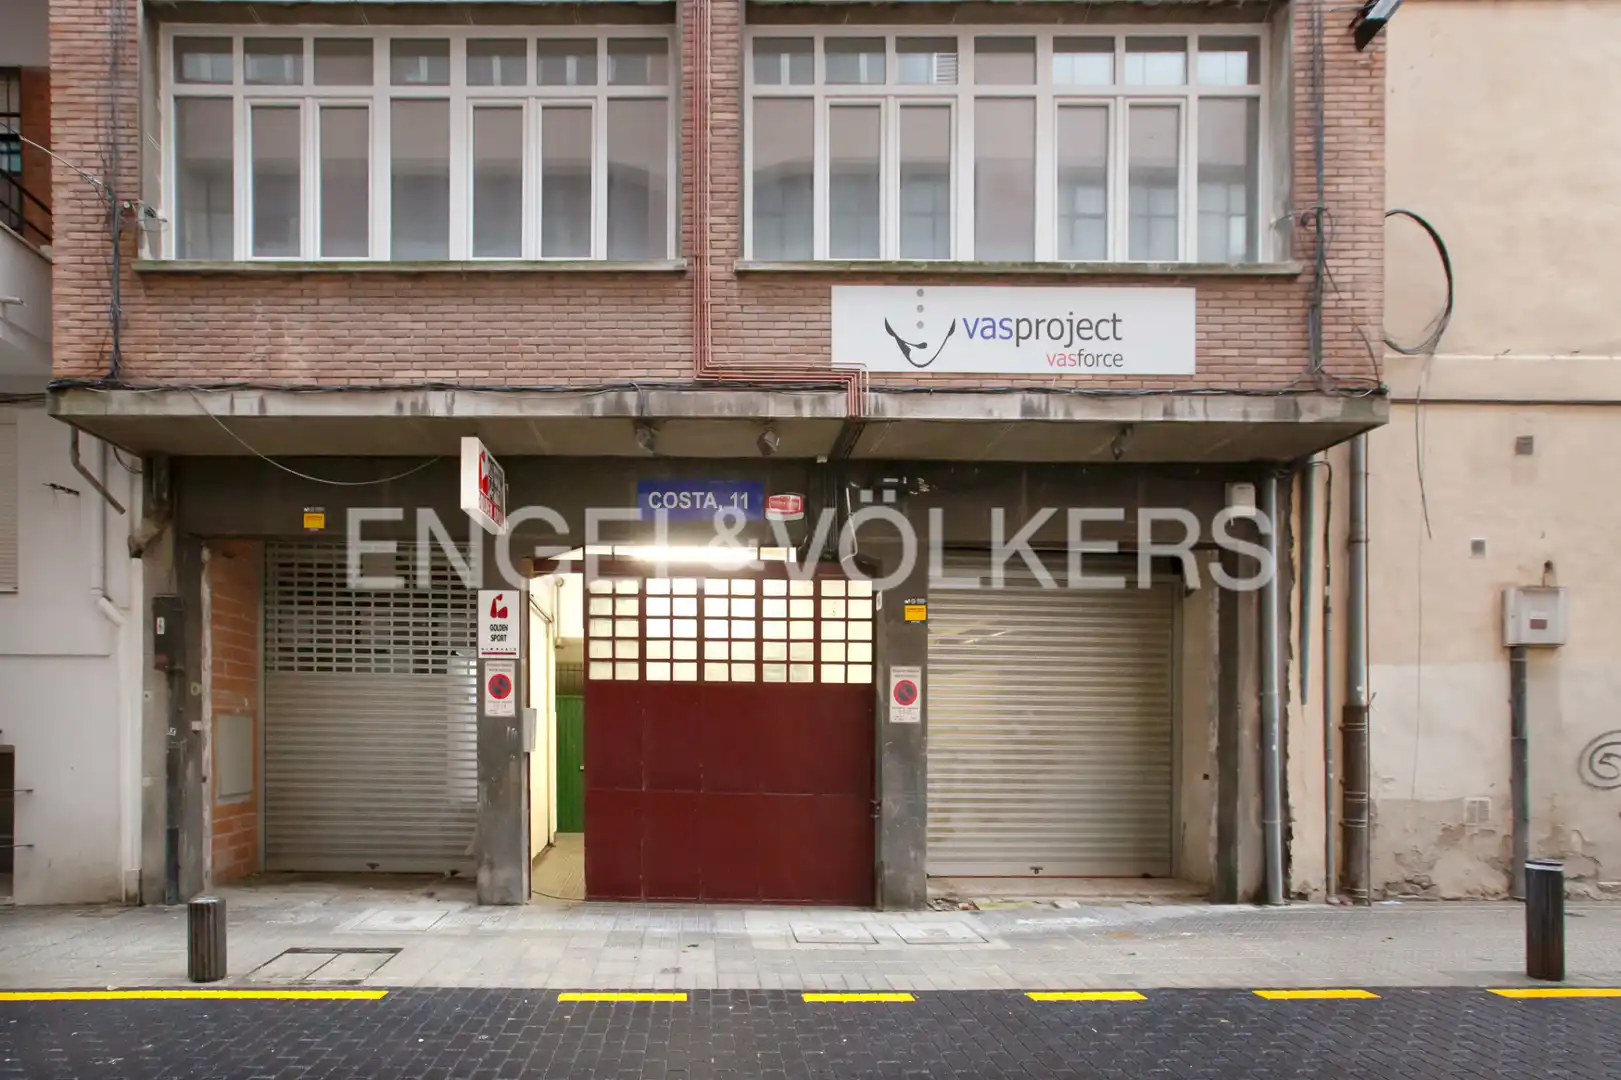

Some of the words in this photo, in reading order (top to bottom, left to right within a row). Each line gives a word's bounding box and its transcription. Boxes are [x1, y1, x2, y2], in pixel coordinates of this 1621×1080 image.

[963, 311, 1123, 348] vasproject
[1046, 348, 1124, 368] vasforce
[648, 491, 723, 511] COSTA,
[730, 491, 748, 510] 11
[489, 624, 508, 632] GOLDEN
[490, 634, 507, 642] SPORT
